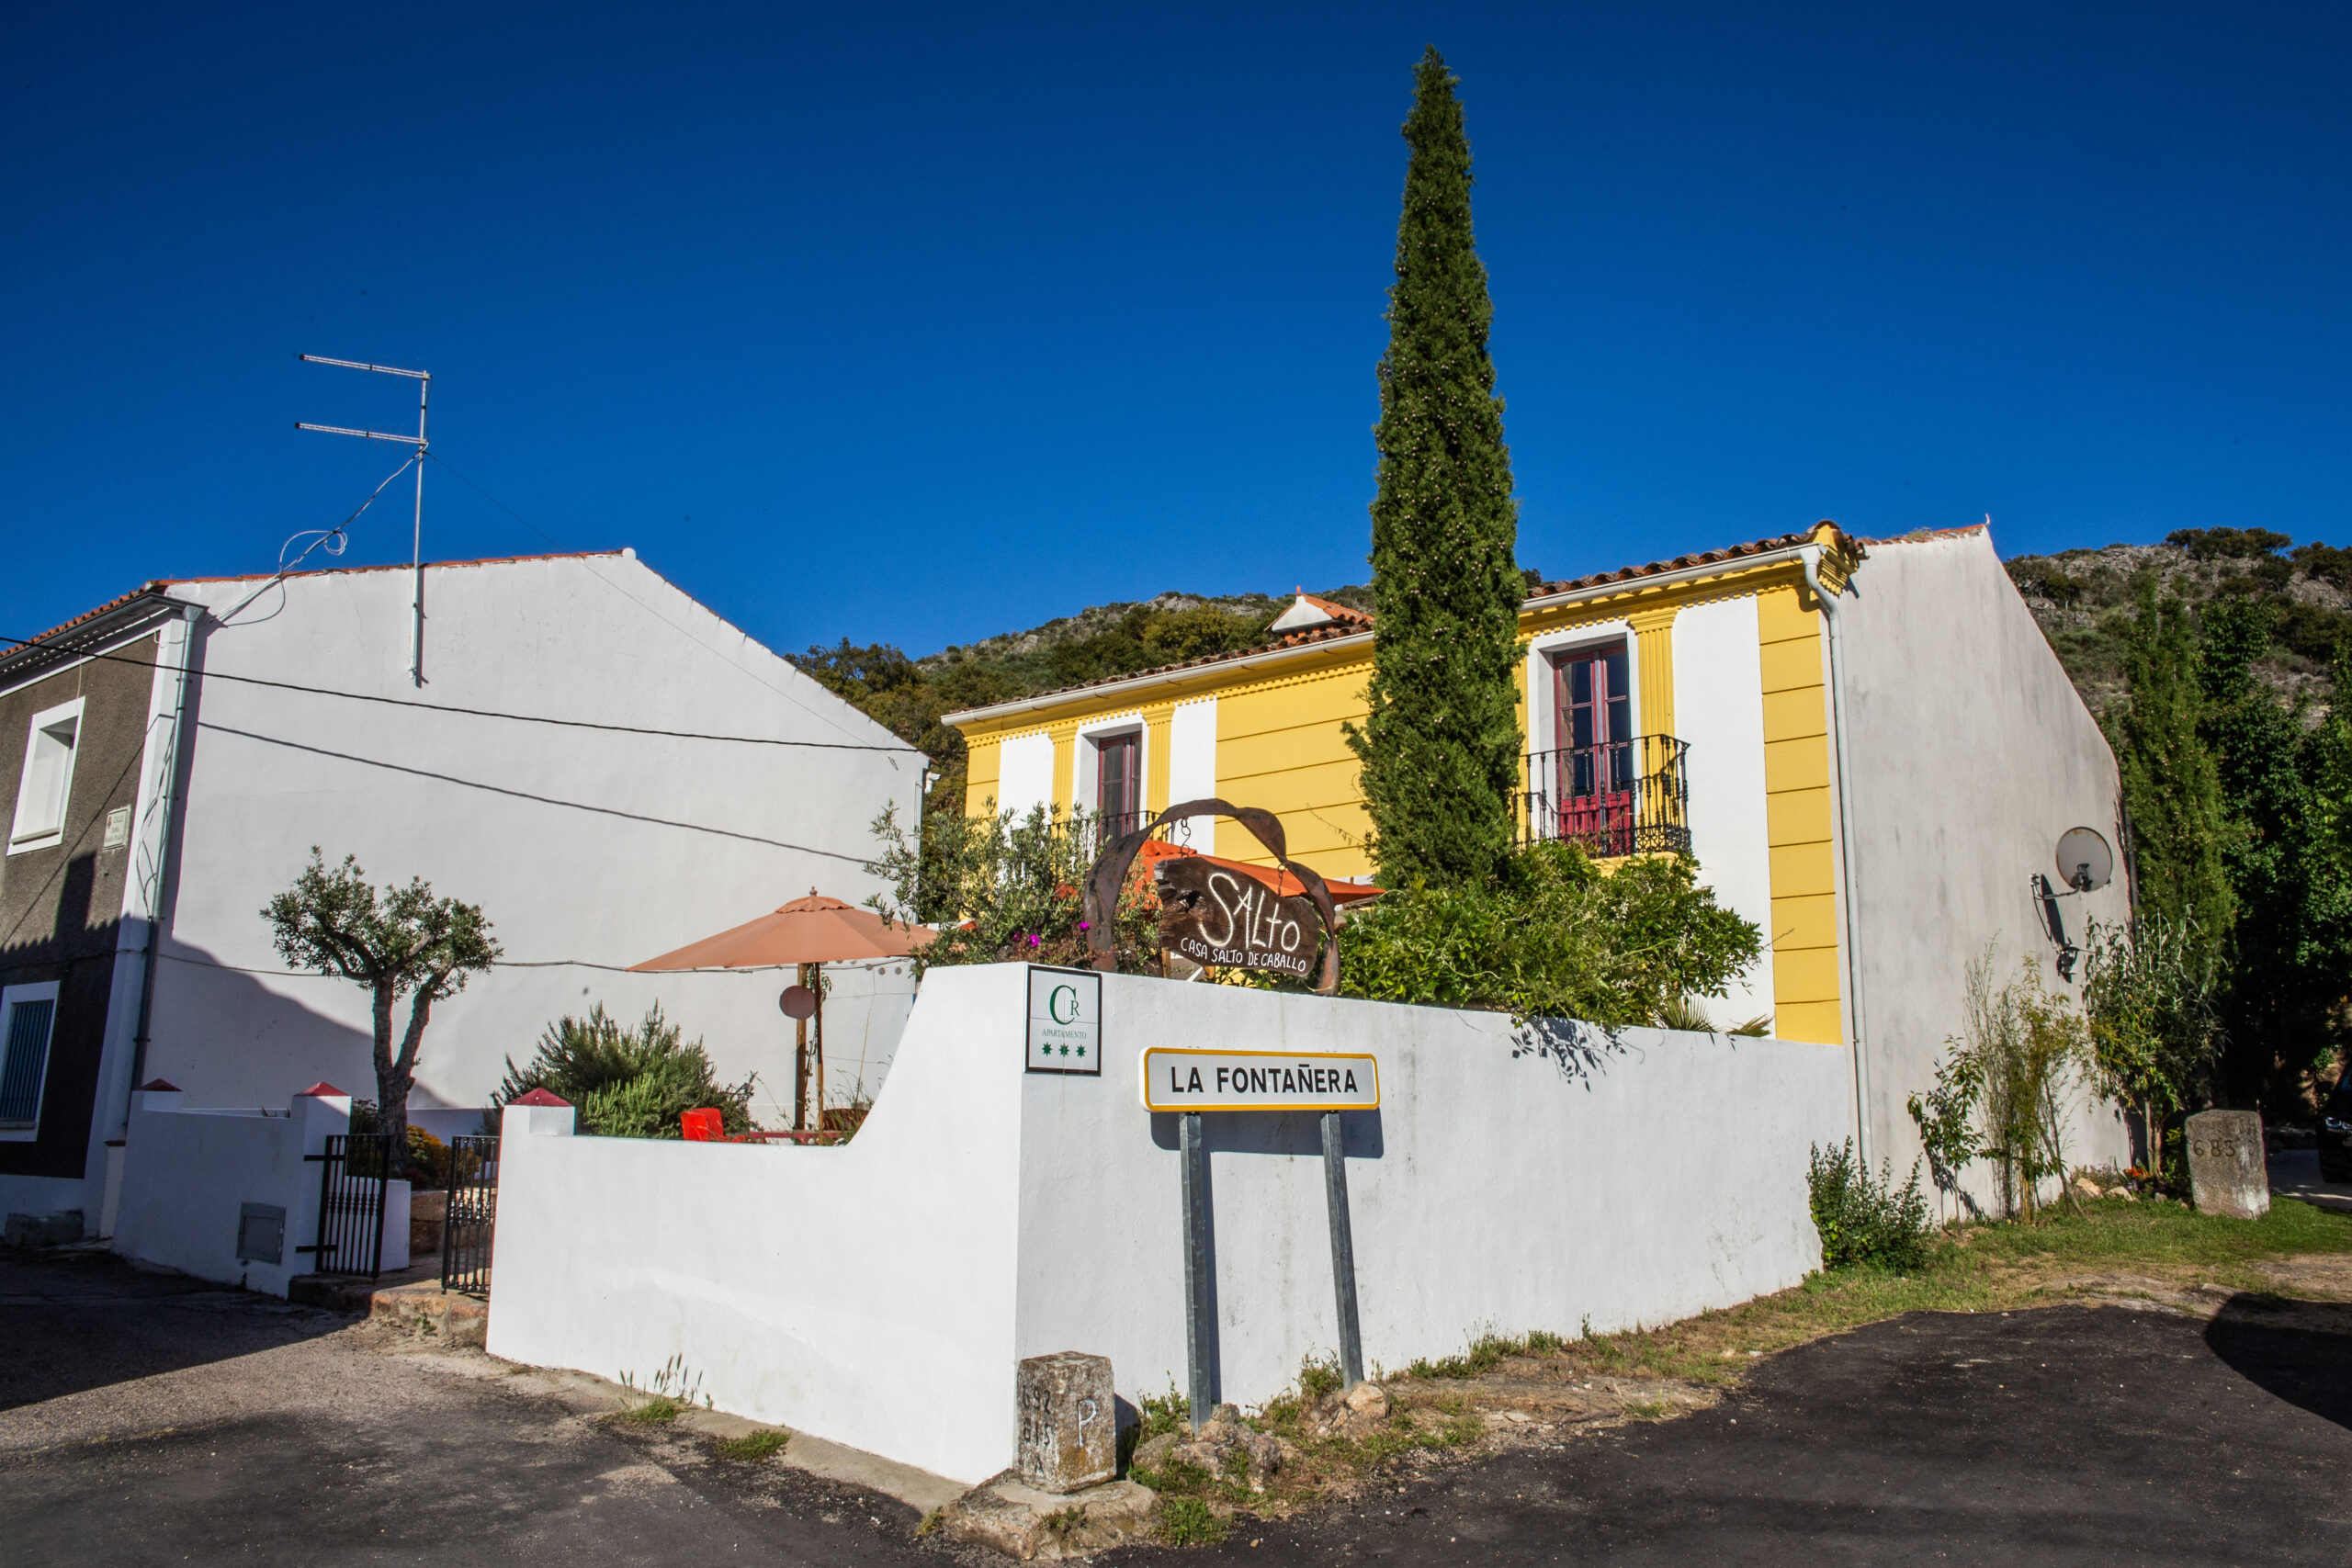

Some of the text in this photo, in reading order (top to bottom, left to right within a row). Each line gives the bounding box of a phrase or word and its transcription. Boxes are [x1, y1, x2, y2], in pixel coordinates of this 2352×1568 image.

[1181, 937, 1306, 973] CASA SALTO DE CABALLO
[1042, 1029, 1087, 1040] APARTAMENTO
[1170, 1063, 1359, 1093] LA FONTAÑERA
[1078, 1398, 1097, 1449] P
